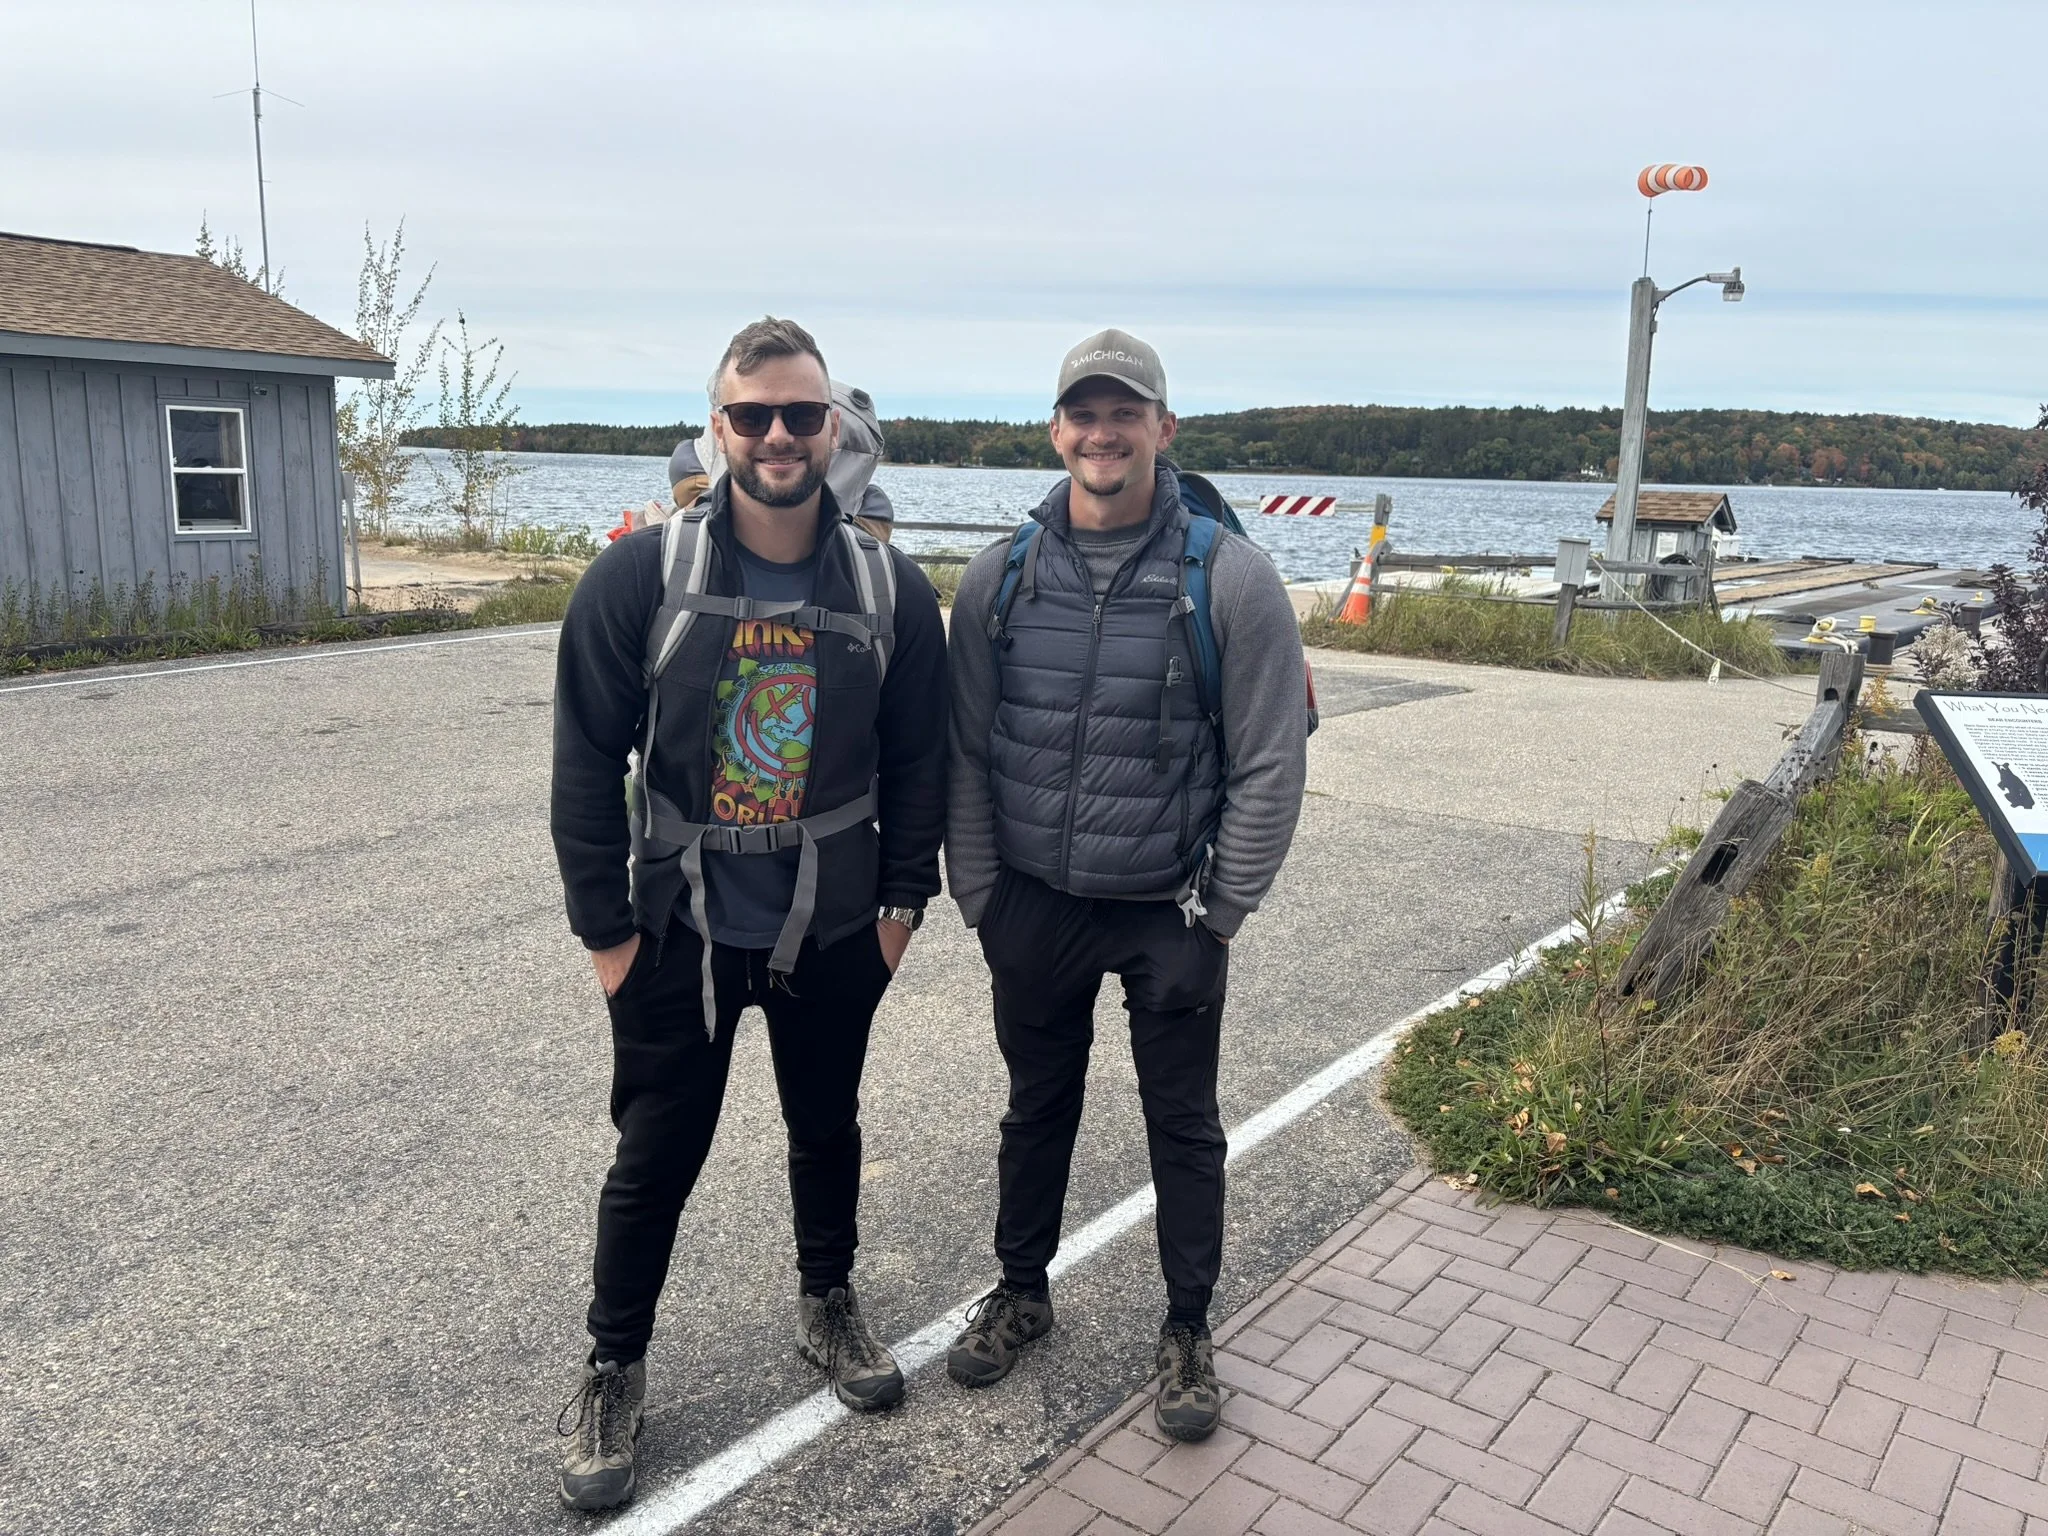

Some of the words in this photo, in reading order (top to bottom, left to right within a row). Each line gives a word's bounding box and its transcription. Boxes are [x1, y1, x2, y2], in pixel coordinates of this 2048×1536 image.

[1078, 350, 1143, 368] MICHIGAN
[1942, 700, 1985, 713] What
[1985, 701, 2019, 714] You
